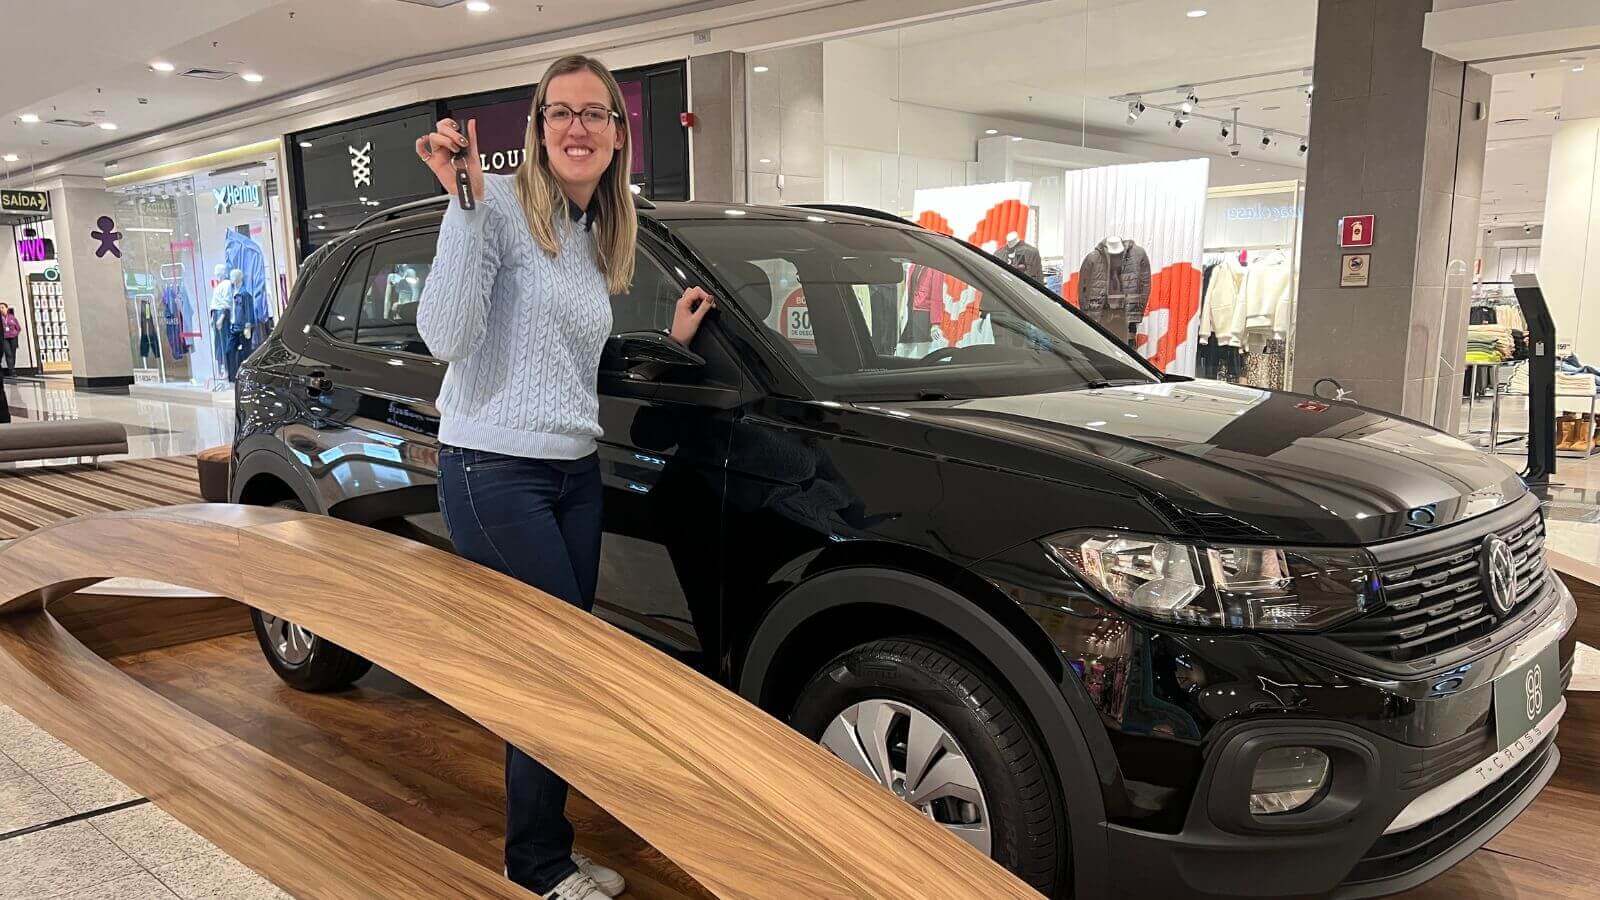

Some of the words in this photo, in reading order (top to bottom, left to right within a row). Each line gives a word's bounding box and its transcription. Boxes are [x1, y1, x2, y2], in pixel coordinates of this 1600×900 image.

[2, 193, 38, 207] SAÍDA
[227, 184, 259, 208] Hering
[791, 311, 810, 329] 30
